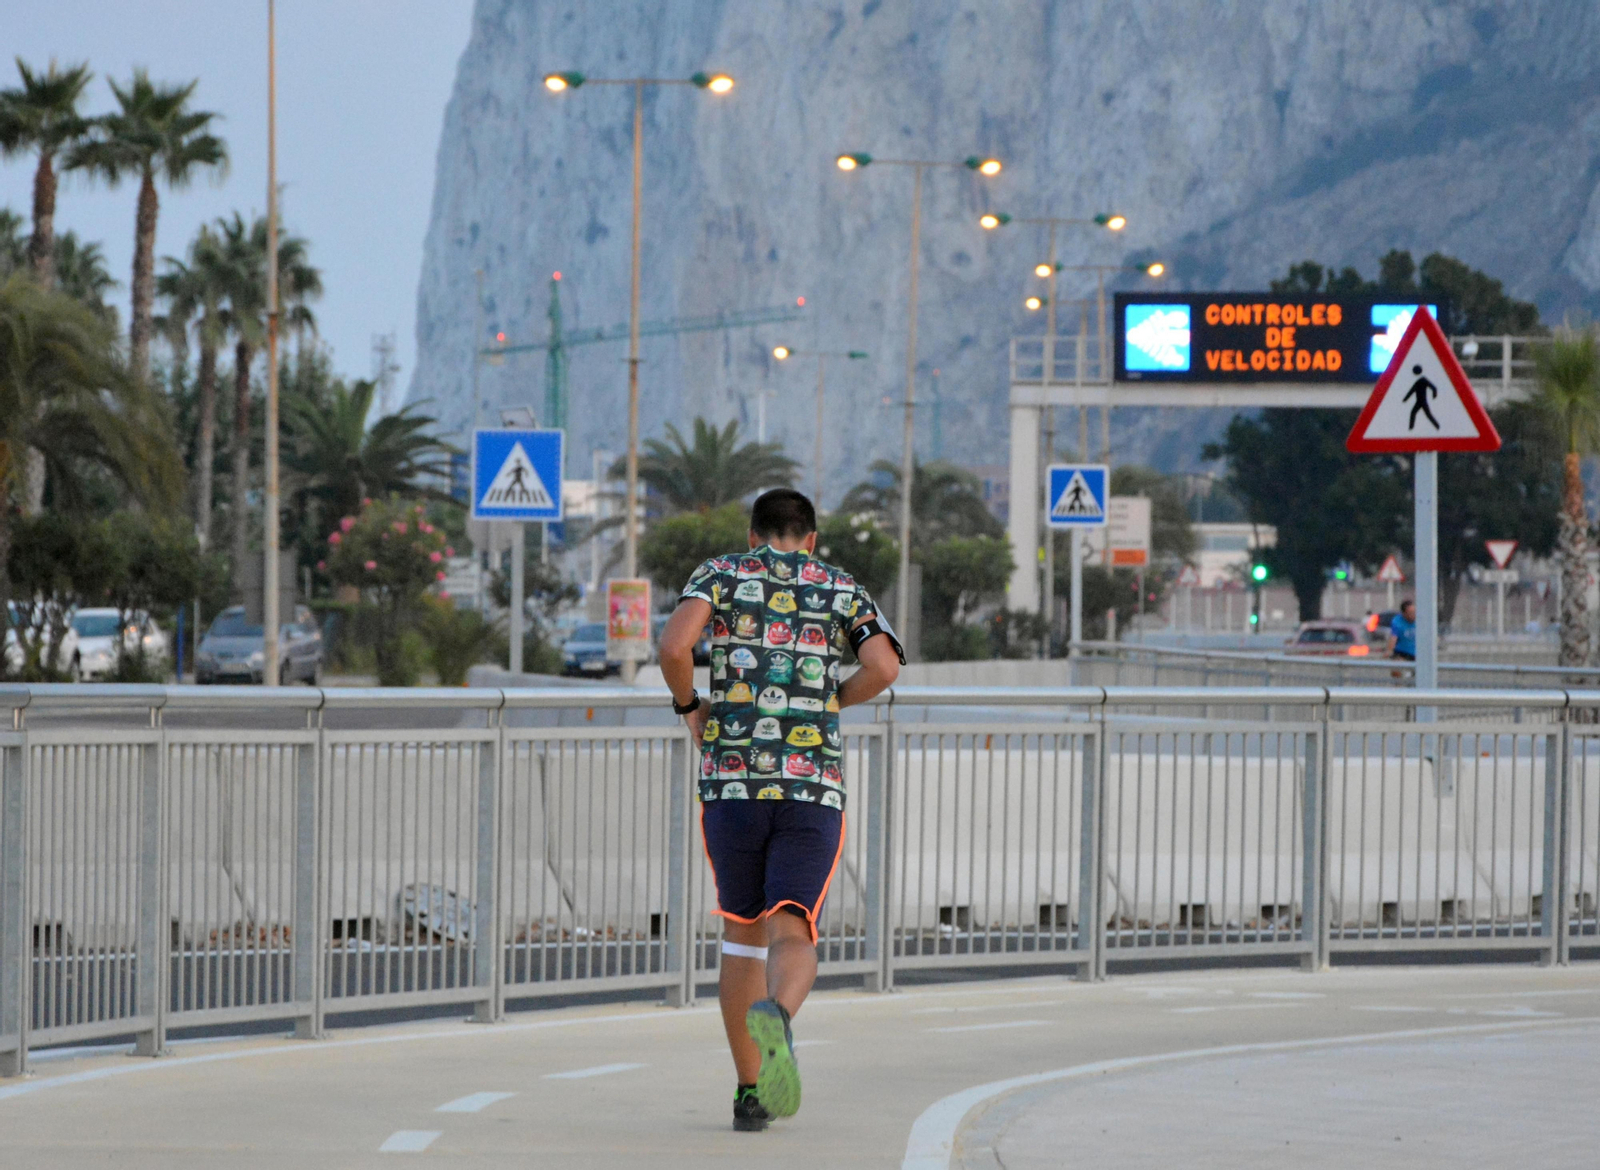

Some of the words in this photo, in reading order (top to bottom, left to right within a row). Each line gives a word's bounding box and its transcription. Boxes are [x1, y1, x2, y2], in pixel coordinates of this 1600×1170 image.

[1205, 304, 1342, 325] CONTROLES
[1265, 327, 1296, 348] DE
[1205, 350, 1342, 371] VELOCIDAD
